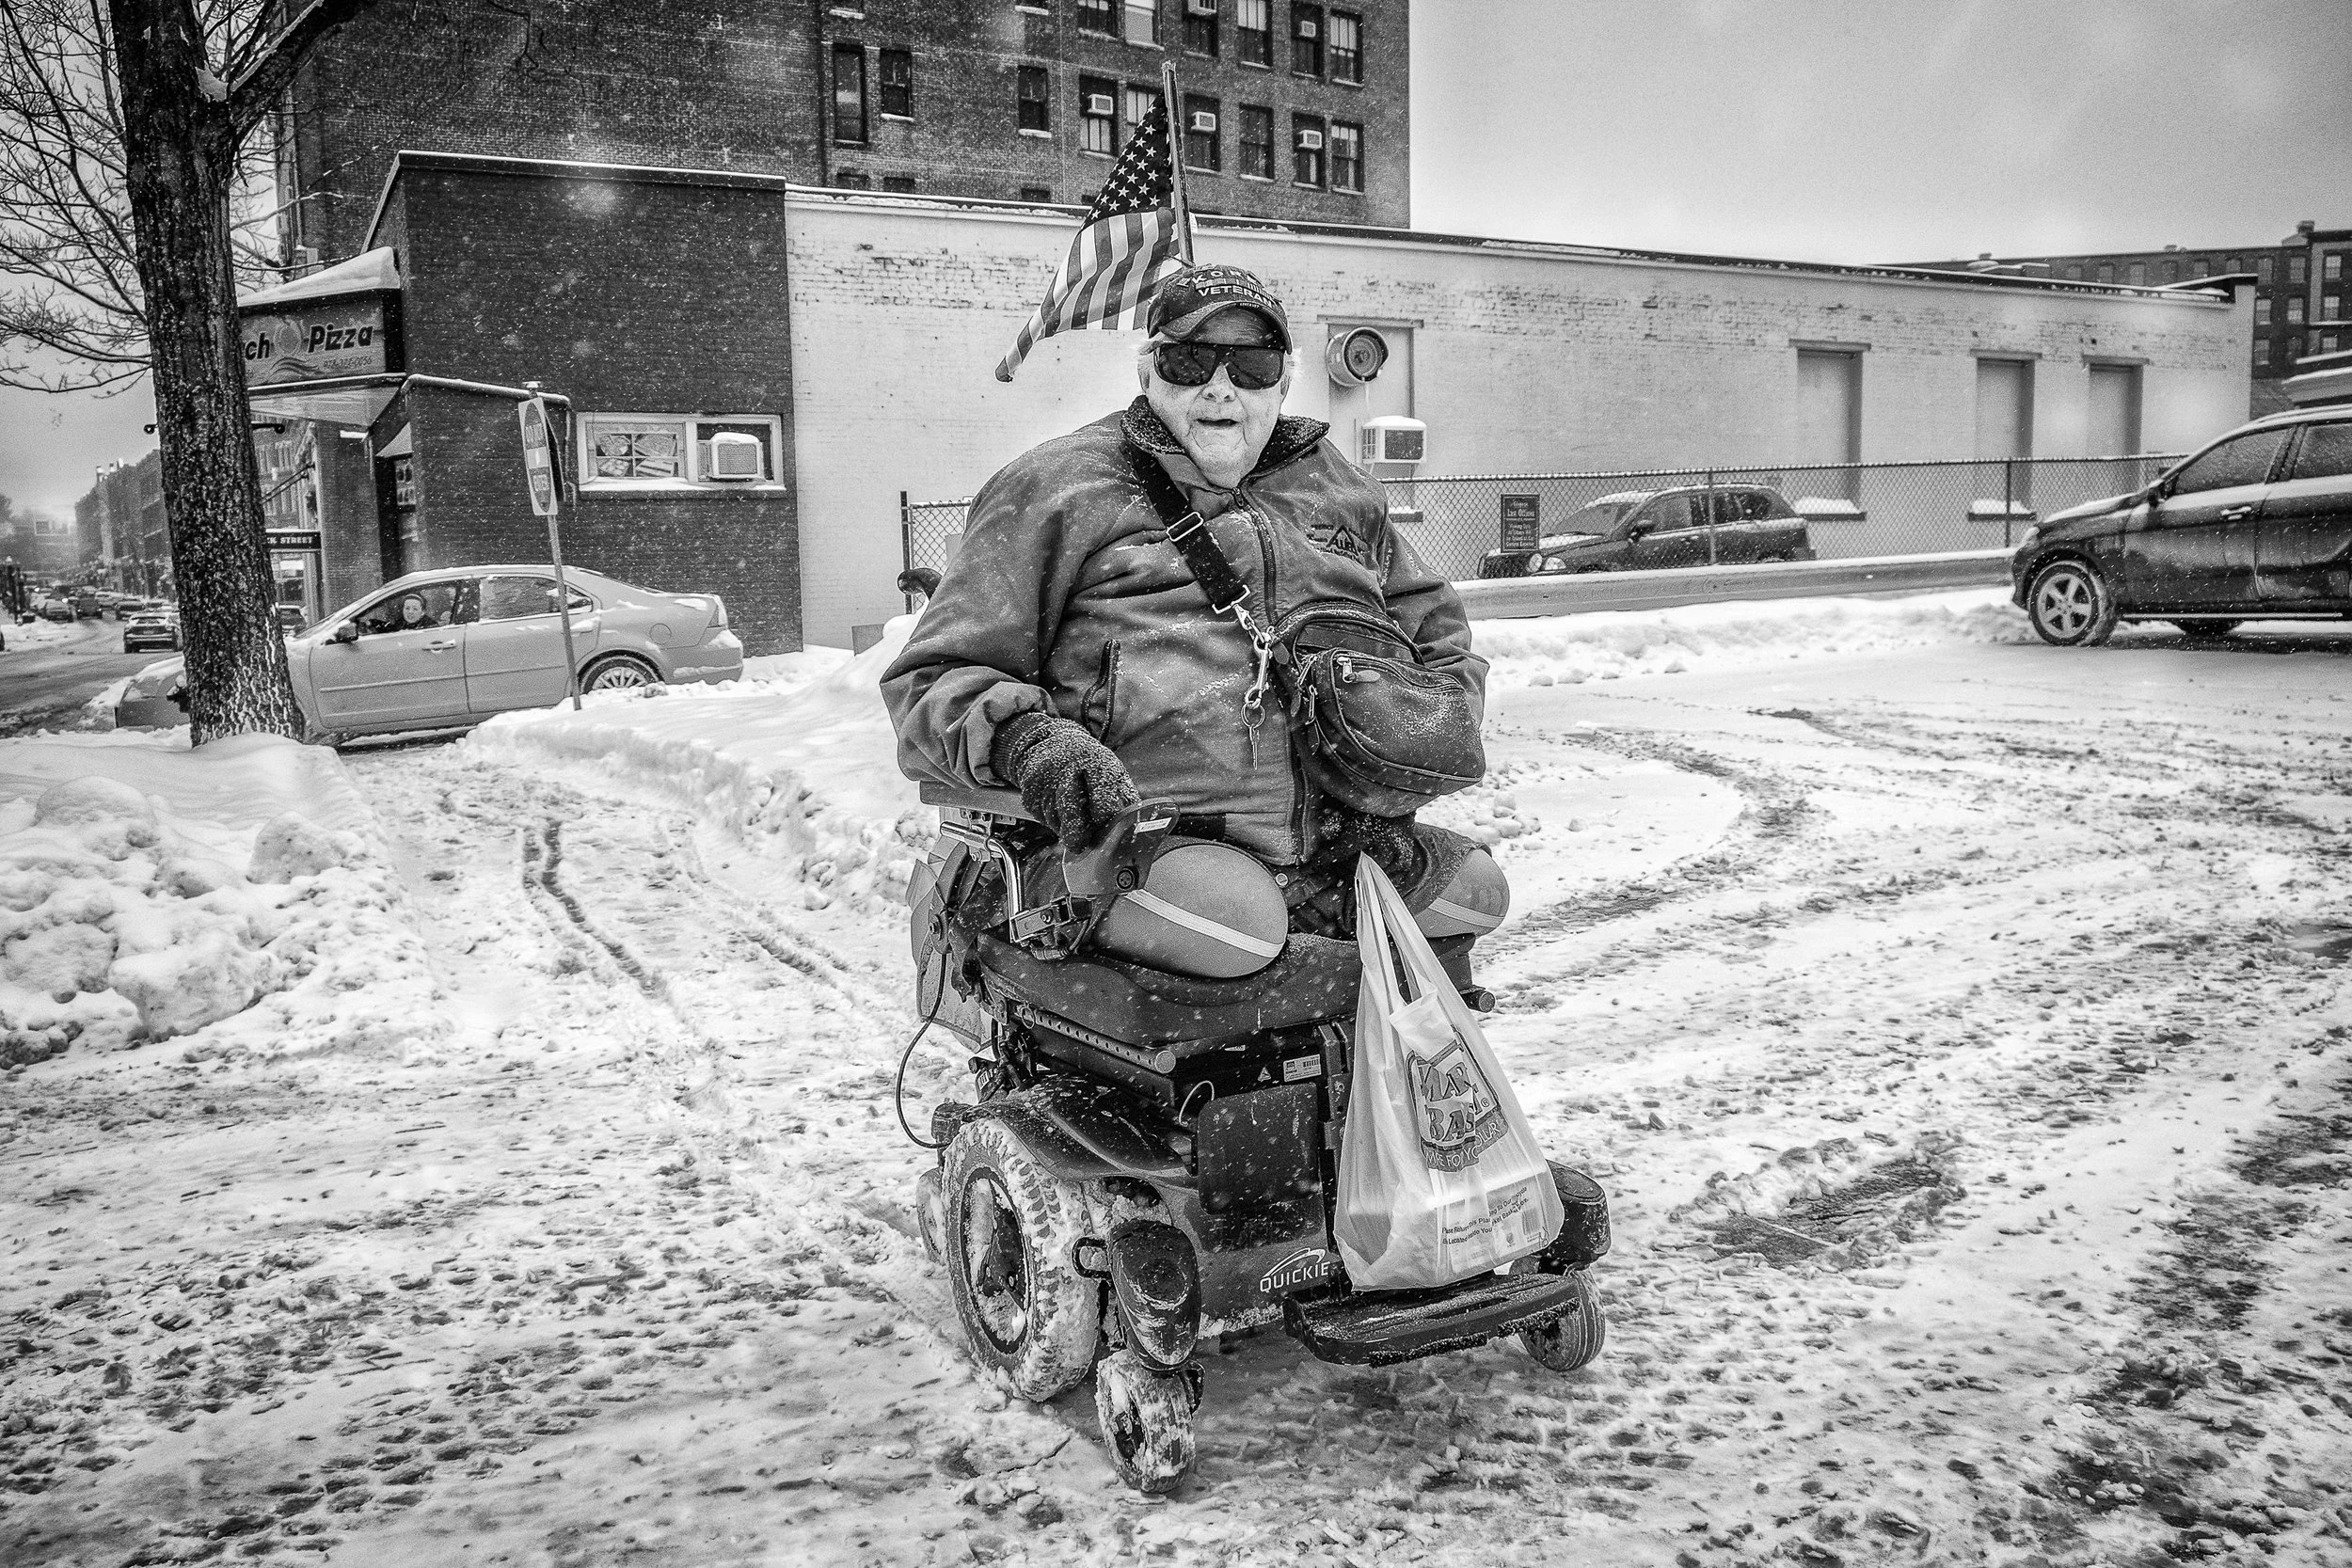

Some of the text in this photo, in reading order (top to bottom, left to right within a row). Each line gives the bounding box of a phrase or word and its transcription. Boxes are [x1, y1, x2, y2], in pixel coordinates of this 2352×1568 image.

[1198, 284, 1274, 309] VETERAN
[245, 324, 373, 360] ch Pizza
[1260, 1261, 1330, 1293] QUICKIE
